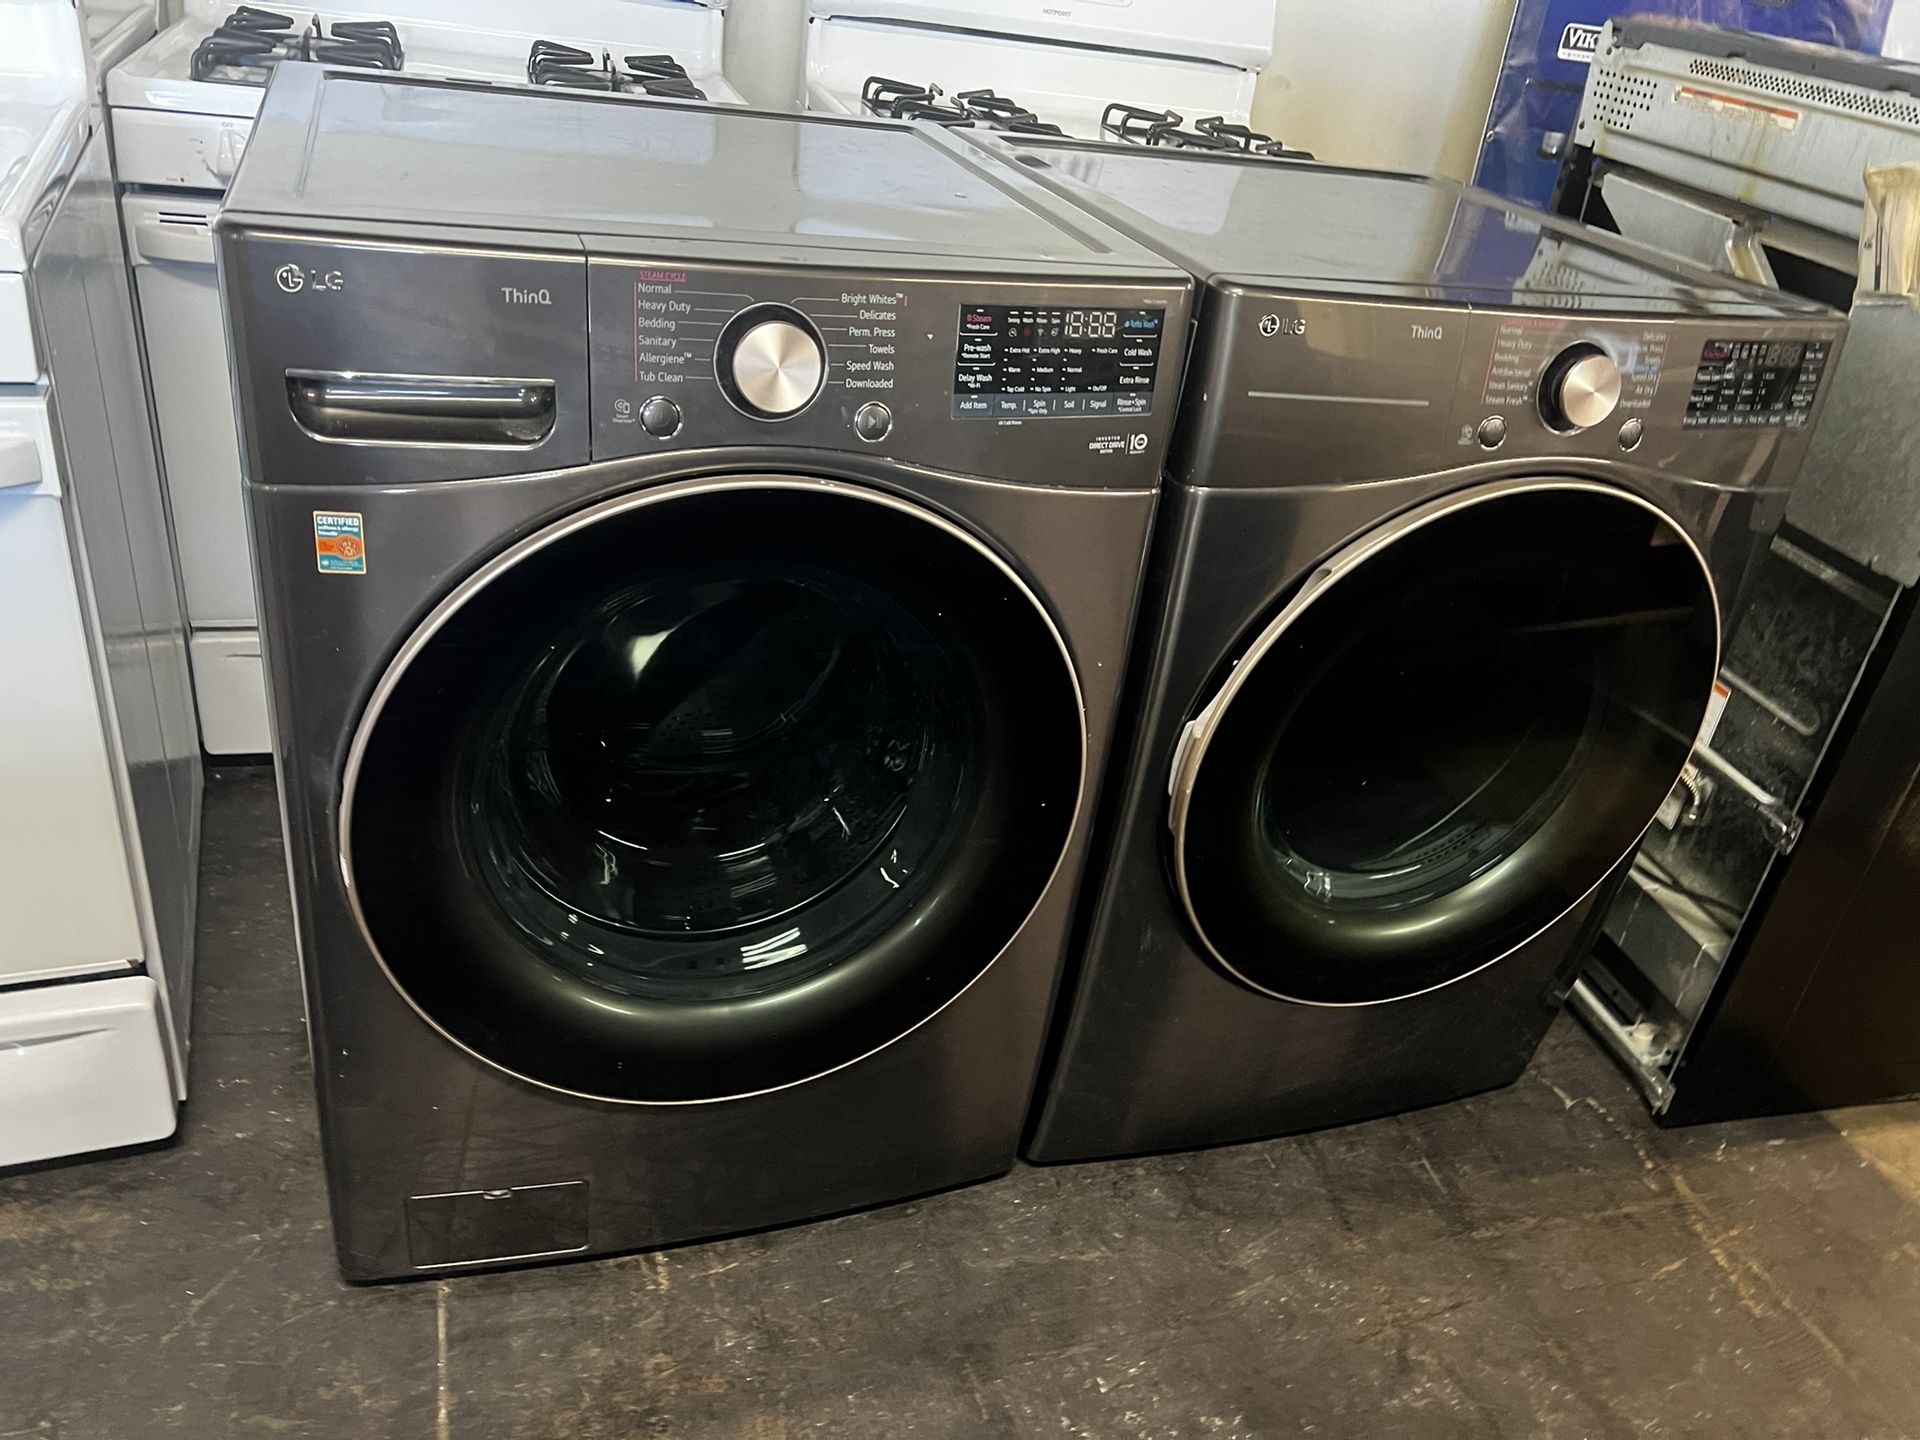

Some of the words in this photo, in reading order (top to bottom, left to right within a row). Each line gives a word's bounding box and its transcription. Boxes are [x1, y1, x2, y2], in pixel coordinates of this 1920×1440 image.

[310, 269, 343, 291] LG
[638, 282, 672, 294] Normal
[501, 286, 552, 305] ThinQ
[841, 293, 867, 306] Bright
[638, 299, 666, 313] Heavy
[669, 301, 691, 314] Duty
[859, 309, 897, 320] Delicates
[638, 317, 676, 331] Bedding
[1282, 317, 1306, 334] LG
[848, 326, 872, 337] Perm.
[873, 326, 896, 338] Press
[1411, 324, 1442, 340] ThinQ
[638, 335, 677, 349] Sanitary
[868, 344, 895, 354] Towels
[1124, 348, 1136, 356] Cold
[1138, 348, 1152, 356] Wash
[846, 360, 871, 373] Speed
[872, 360, 895, 371] Wash
[639, 371, 656, 382] Tub
[657, 372, 684, 382] Clean
[958, 374, 976, 384] Delay
[976, 374, 993, 382] Wash
[1120, 376, 1134, 384] Extra
[1134, 376, 1150, 384] Rinse
[846, 378, 894, 388] Downloaded
[960, 401, 972, 409] Add
[1064, 400, 1075, 408] Soil
[1090, 400, 1107, 410] Signal
[1088, 442, 1108, 450] DIRECT
[316, 516, 360, 526] CERTIFIED
